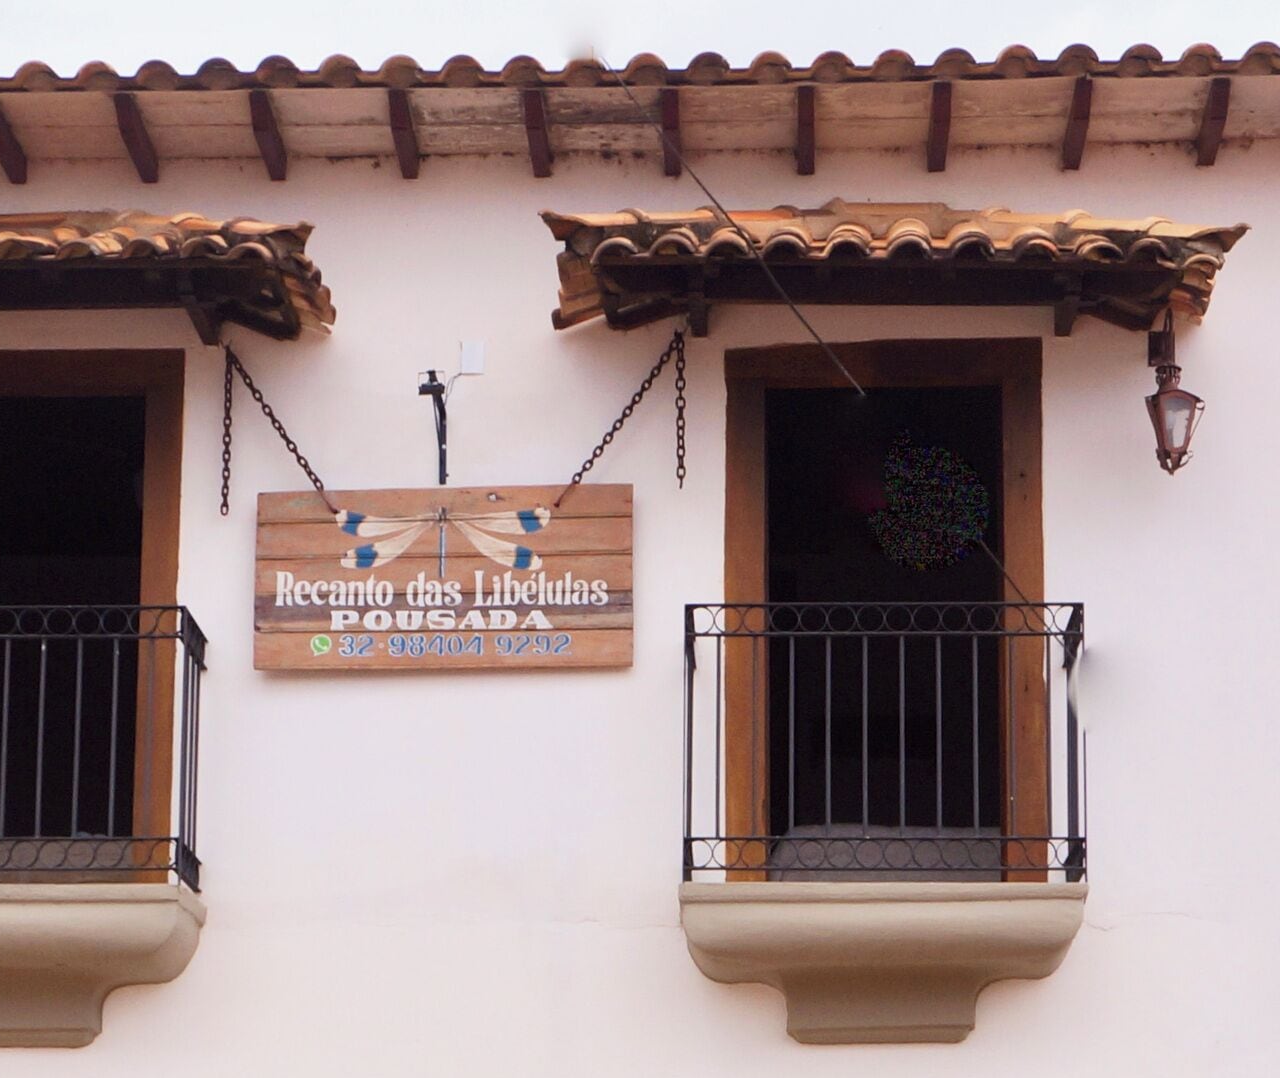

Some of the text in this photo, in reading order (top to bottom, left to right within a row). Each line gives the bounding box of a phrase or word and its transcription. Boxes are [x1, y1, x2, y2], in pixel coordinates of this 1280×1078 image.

[275, 570, 609, 607] Recanto das Libélulas
[330, 609, 553, 631] POUSADA
[495, 633, 572, 657] 9292
